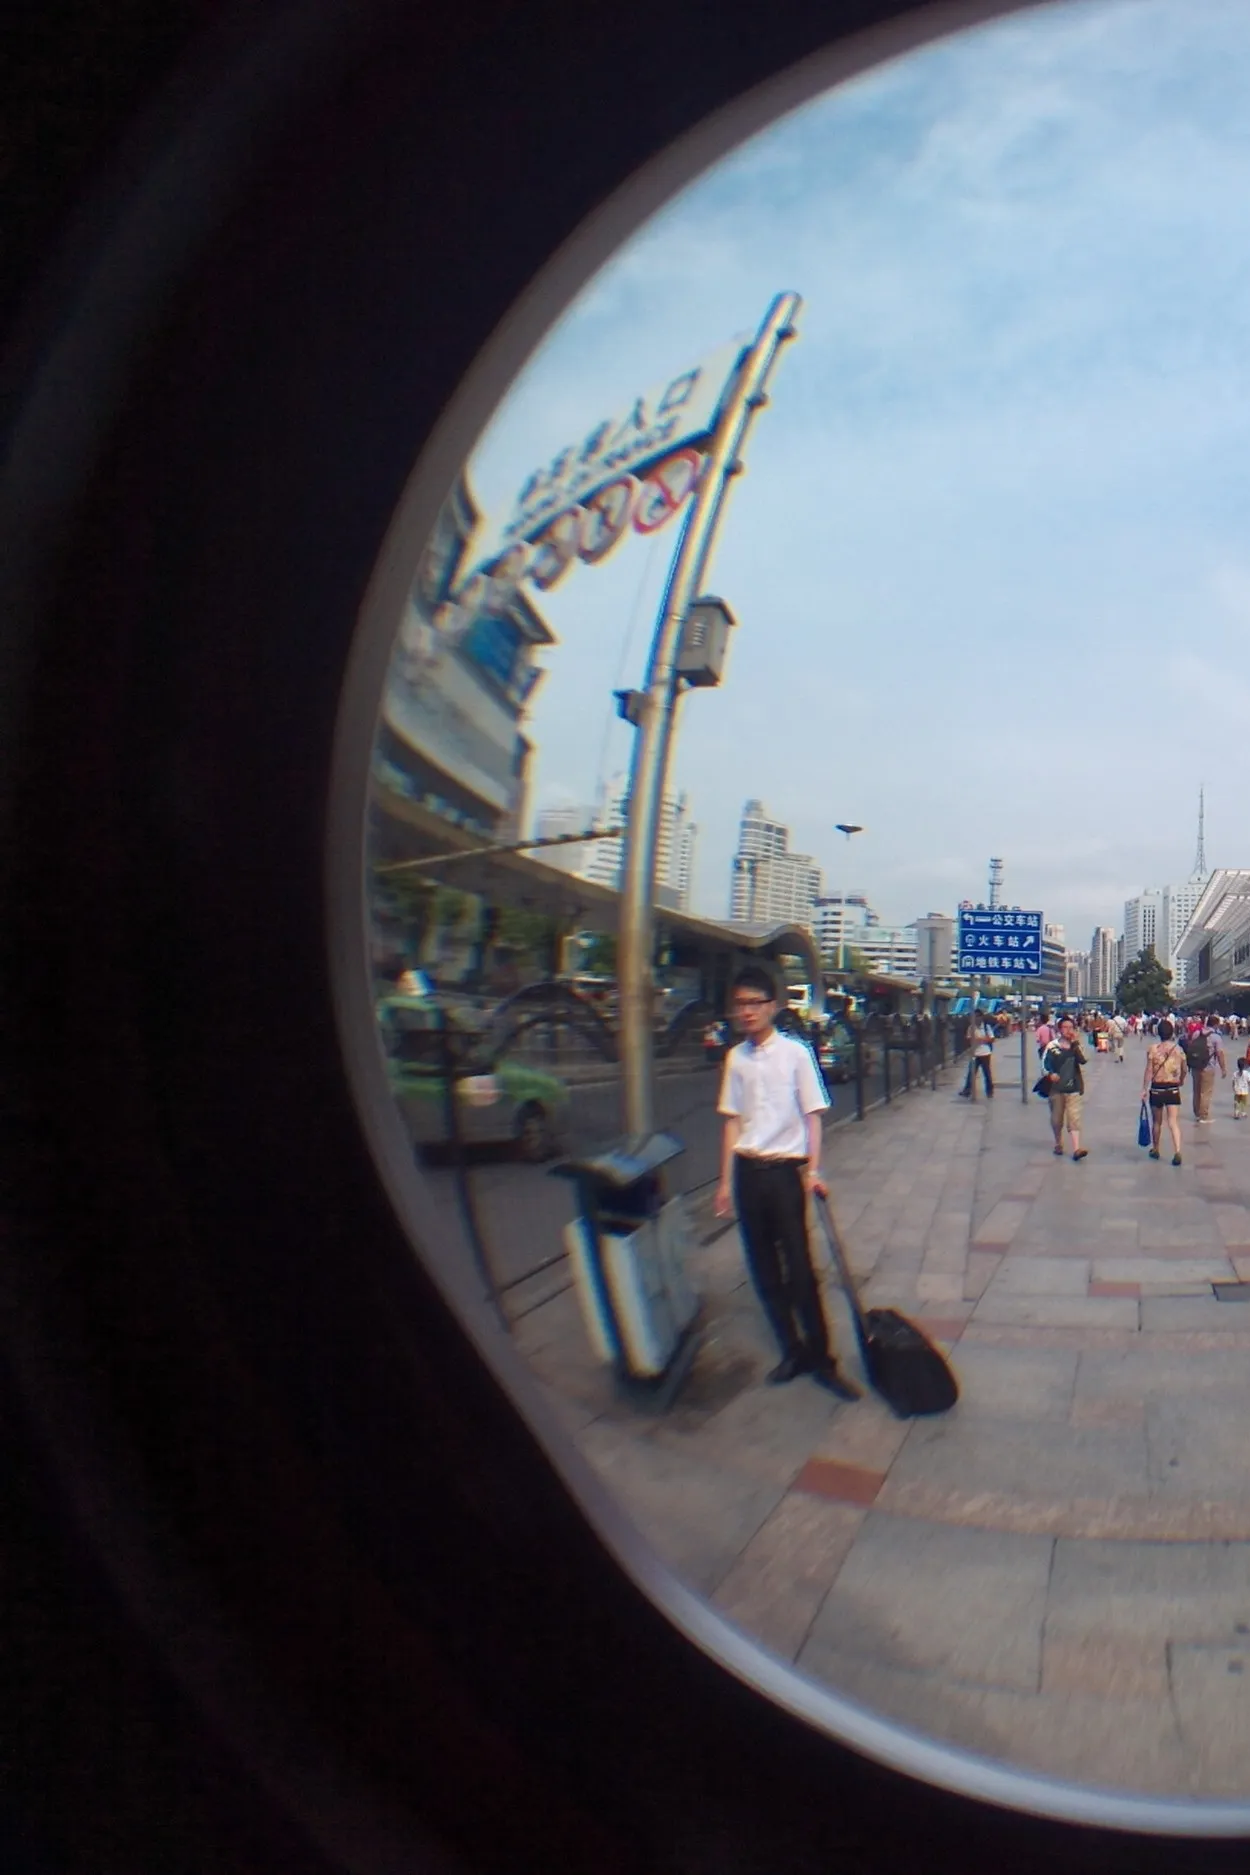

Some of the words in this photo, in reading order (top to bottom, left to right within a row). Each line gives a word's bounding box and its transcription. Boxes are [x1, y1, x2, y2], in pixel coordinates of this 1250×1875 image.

[992, 914, 1039, 927] 公交车站
[978, 934, 1019, 948] 火车站
[975, 956, 1025, 969] 地铁车站
